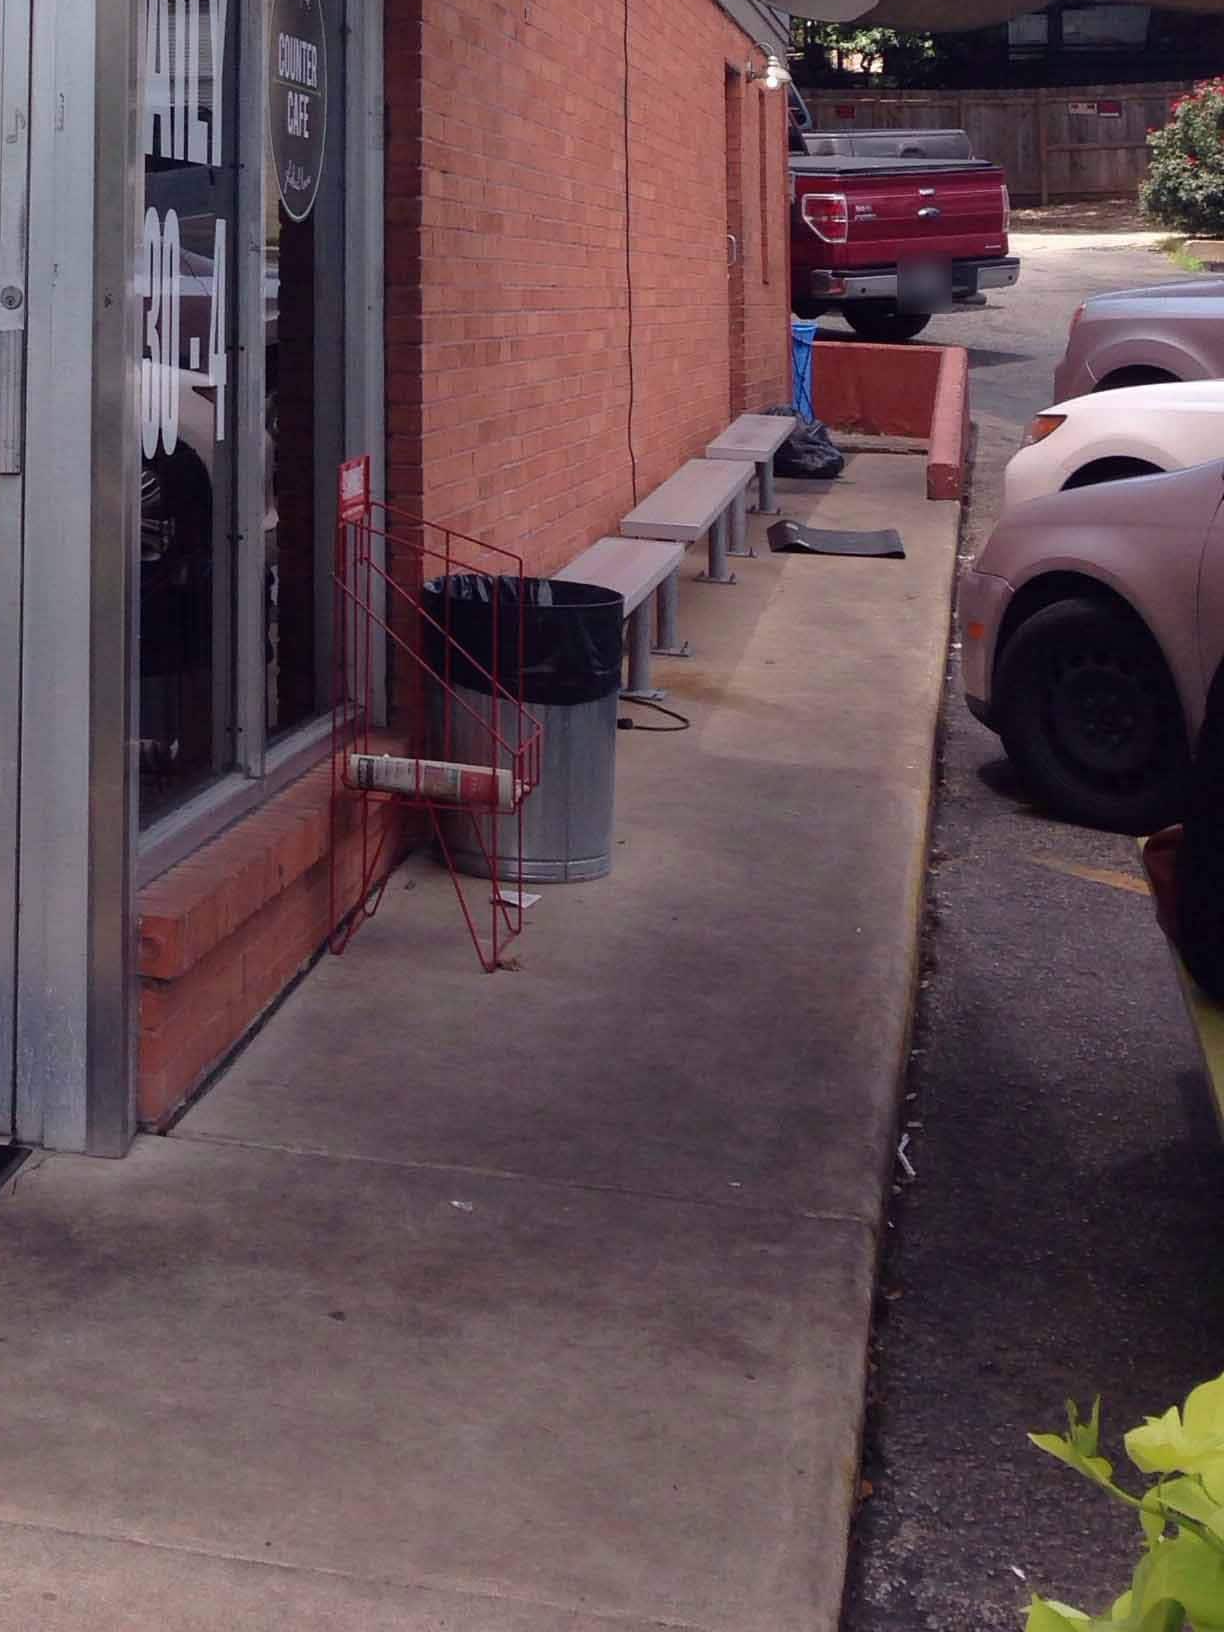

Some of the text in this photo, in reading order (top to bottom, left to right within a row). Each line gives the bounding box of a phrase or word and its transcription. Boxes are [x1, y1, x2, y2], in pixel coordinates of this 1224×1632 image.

[279, 32, 318, 88] COUNTER
[287, 90, 310, 139] CAFE
[142, 206, 227, 460] 30-4
